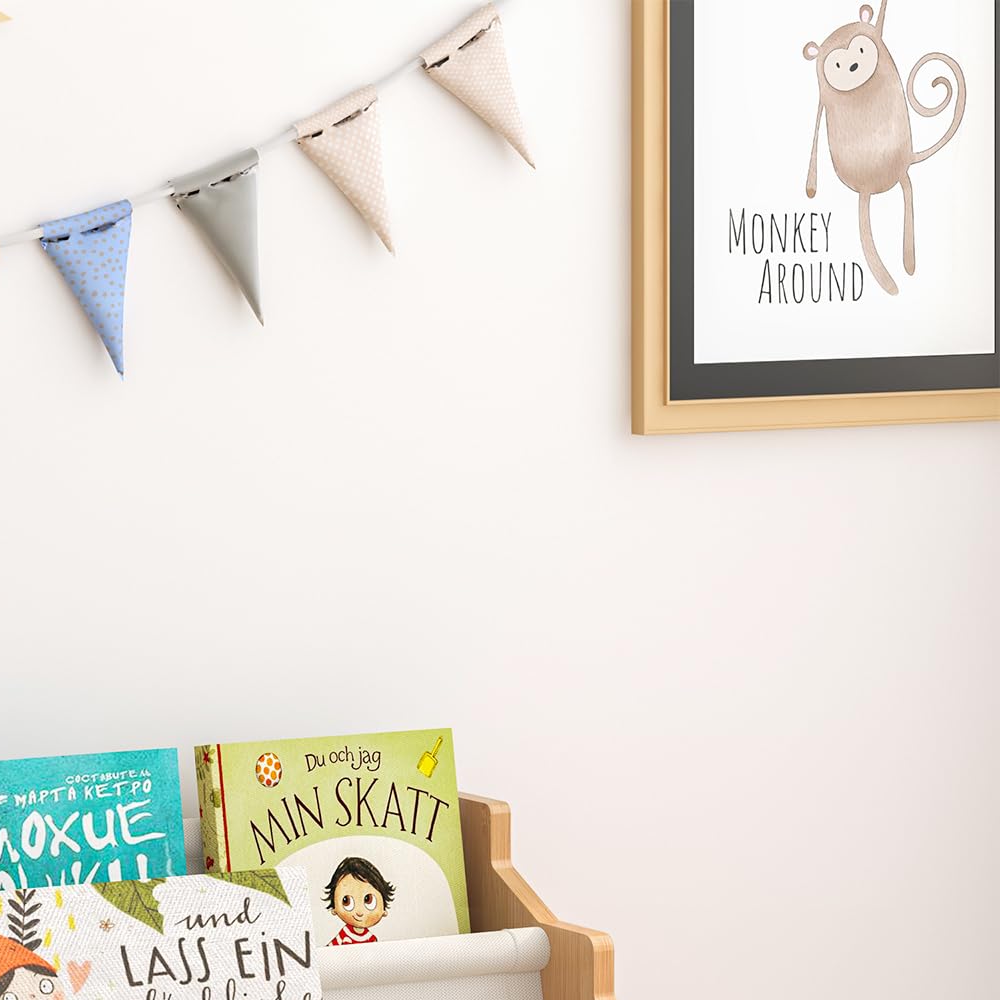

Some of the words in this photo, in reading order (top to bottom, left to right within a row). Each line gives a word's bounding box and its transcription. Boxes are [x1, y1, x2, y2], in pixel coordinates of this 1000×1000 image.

[728, 207, 832, 256] MONKEY
[758, 258, 864, 305] AROUND
[305, 752, 326, 773] Du
[329, 745, 354, 763] och
[351, 746, 382, 772] jag
[14, 784, 77, 807] МАРТА
[84, 778, 152, 799] КЕТРО
[250, 786, 325, 866] MIN
[335, 777, 450, 843] SKATT
[175, 896, 262, 931] und
[120, 935, 211, 987] LASS
